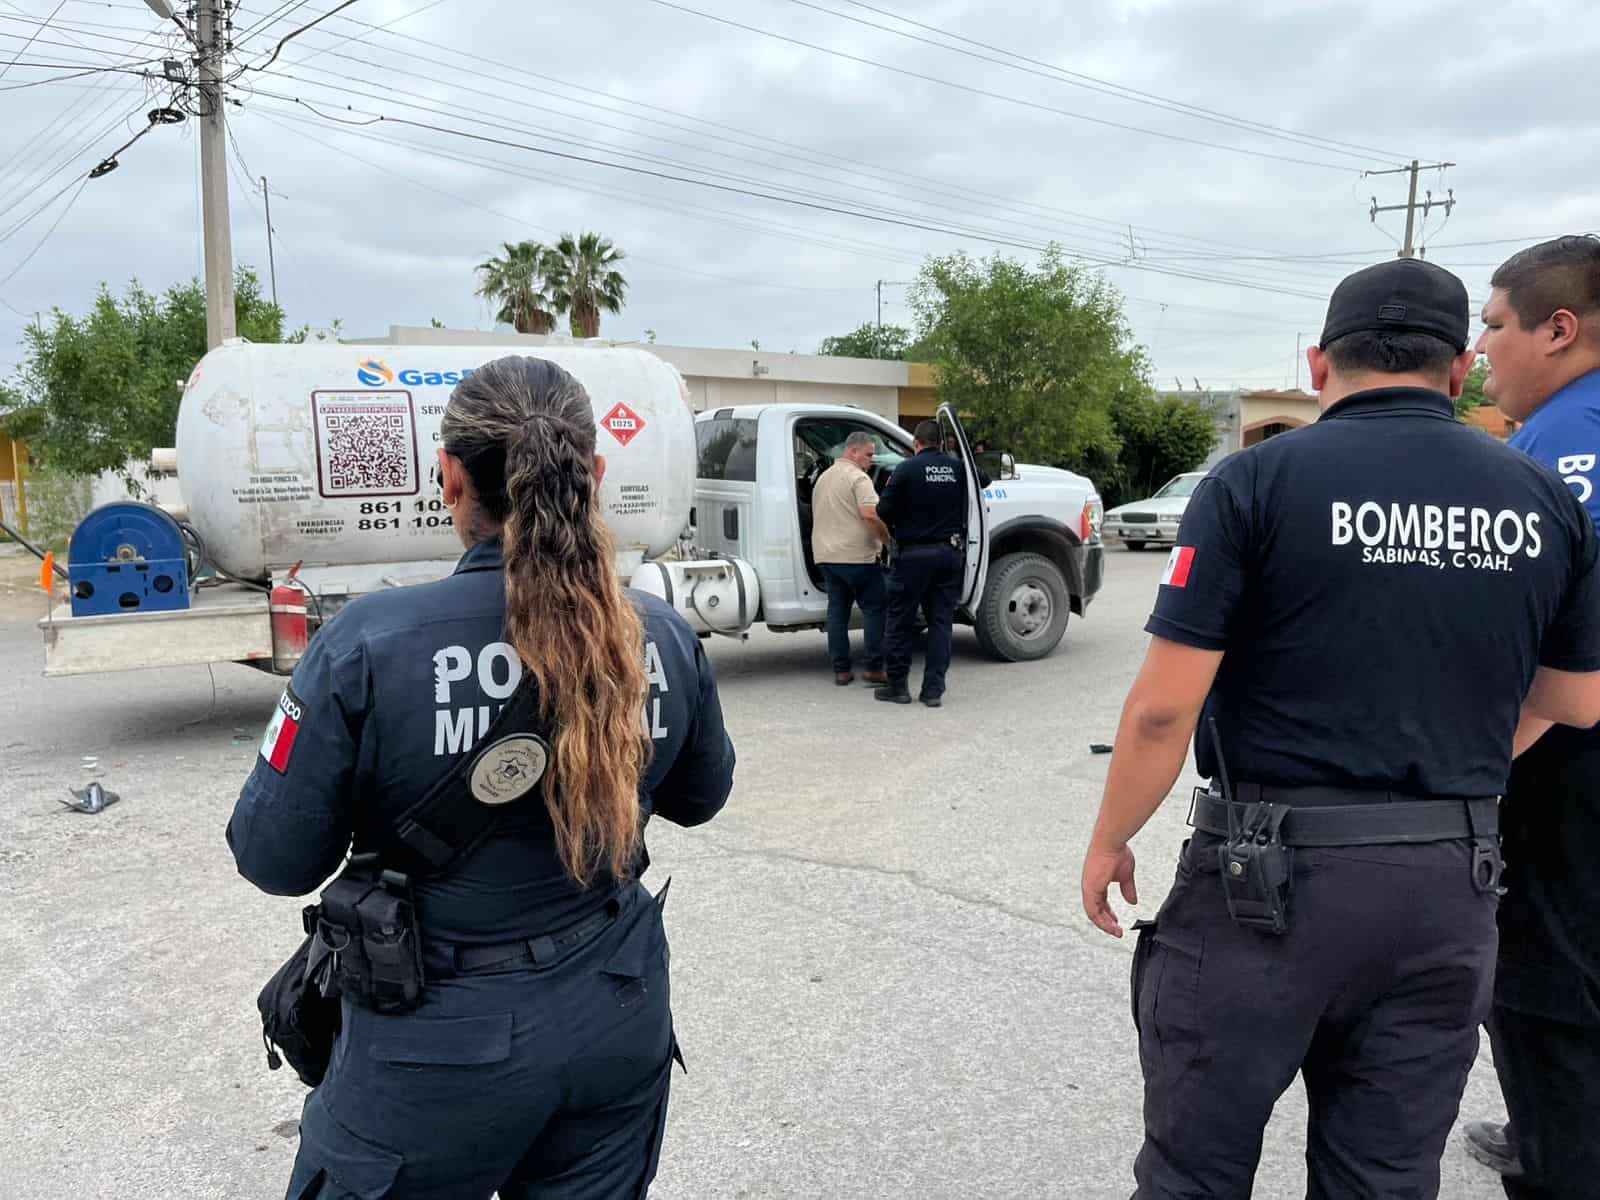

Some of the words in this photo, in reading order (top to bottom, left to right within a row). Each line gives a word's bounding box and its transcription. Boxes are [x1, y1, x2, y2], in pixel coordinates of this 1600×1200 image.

[611, 420, 633, 428] 1075
[360, 501, 401, 514] 861
[414, 500, 448, 512] 10
[358, 518, 400, 530] 861
[1331, 501, 1542, 558] BOMBEROS
[1362, 547, 1446, 570] SABINAS,
[1452, 552, 1513, 572] COAH.
